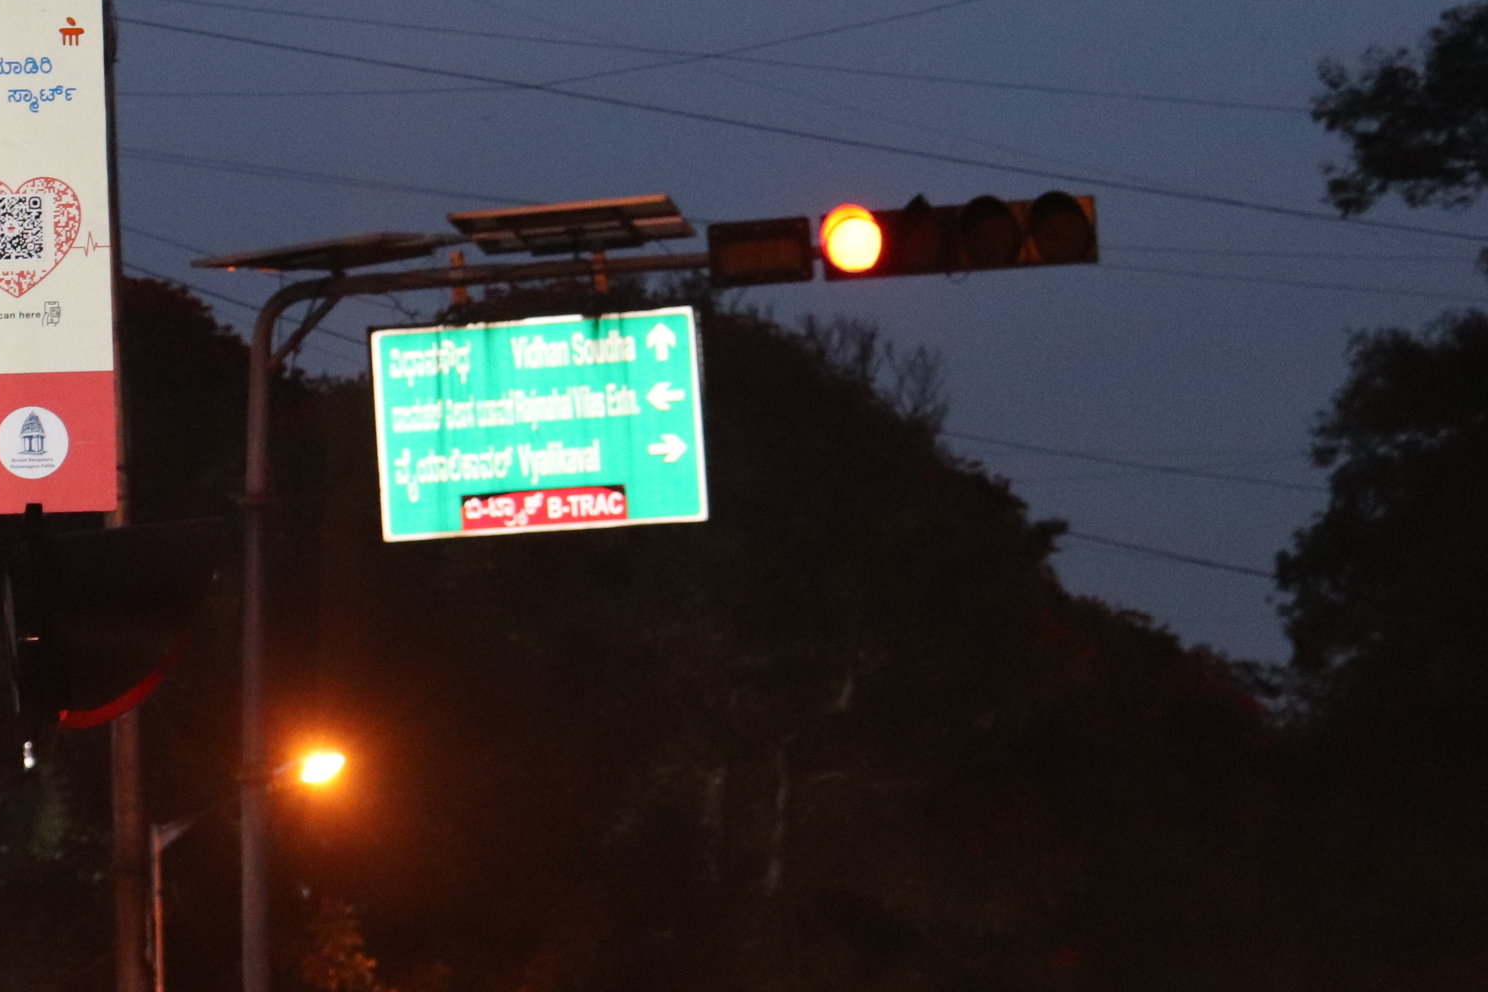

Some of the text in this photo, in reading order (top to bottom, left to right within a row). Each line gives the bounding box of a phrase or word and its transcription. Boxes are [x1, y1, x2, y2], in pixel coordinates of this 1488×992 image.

[7, 85, 76, 113] ಸ್ಮಾರ್ಟ್
[19, 311, 41, 319] here
[512, 330, 637, 369] Vidhan Soudha
[517, 439, 601, 485] Vyalikaval
[547, 492, 624, 519] B-TRAC
